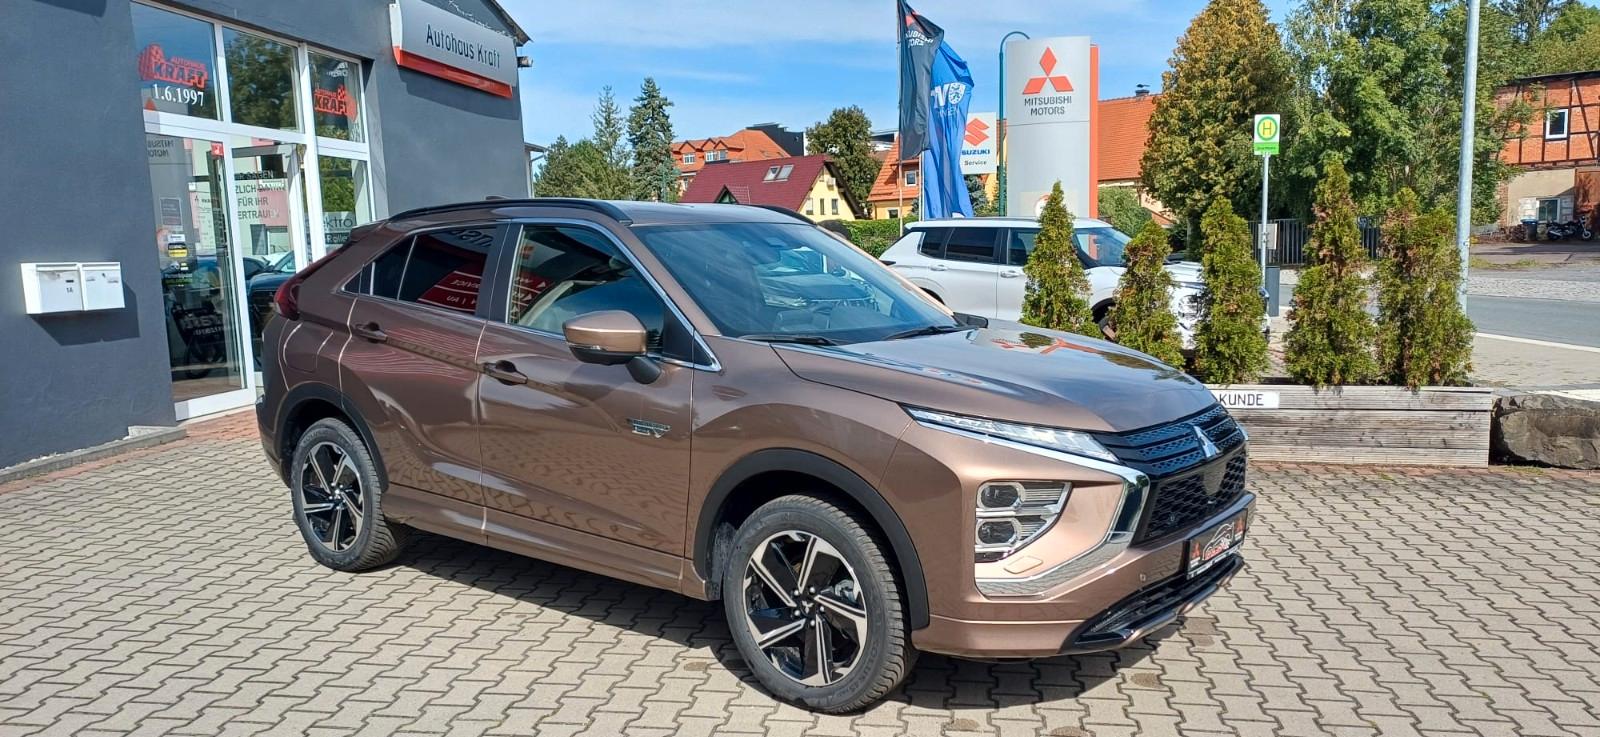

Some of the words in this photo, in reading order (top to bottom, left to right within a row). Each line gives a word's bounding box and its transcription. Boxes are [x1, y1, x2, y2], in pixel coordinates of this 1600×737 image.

[426, 24, 474, 59] Autohaus
[477, 43, 500, 69] Kraft
[152, 61, 208, 89] KRAFT
[153, 83, 204, 107] 1.6.1997
[1024, 95, 1072, 107] MITSUBISHI
[1030, 106, 1065, 116] MOTORS
[1263, 121, 1272, 135] H
[238, 196, 253, 207] FÜR
[255, 196, 269, 206] IHR
[1219, 393, 1264, 406] KUNDE
